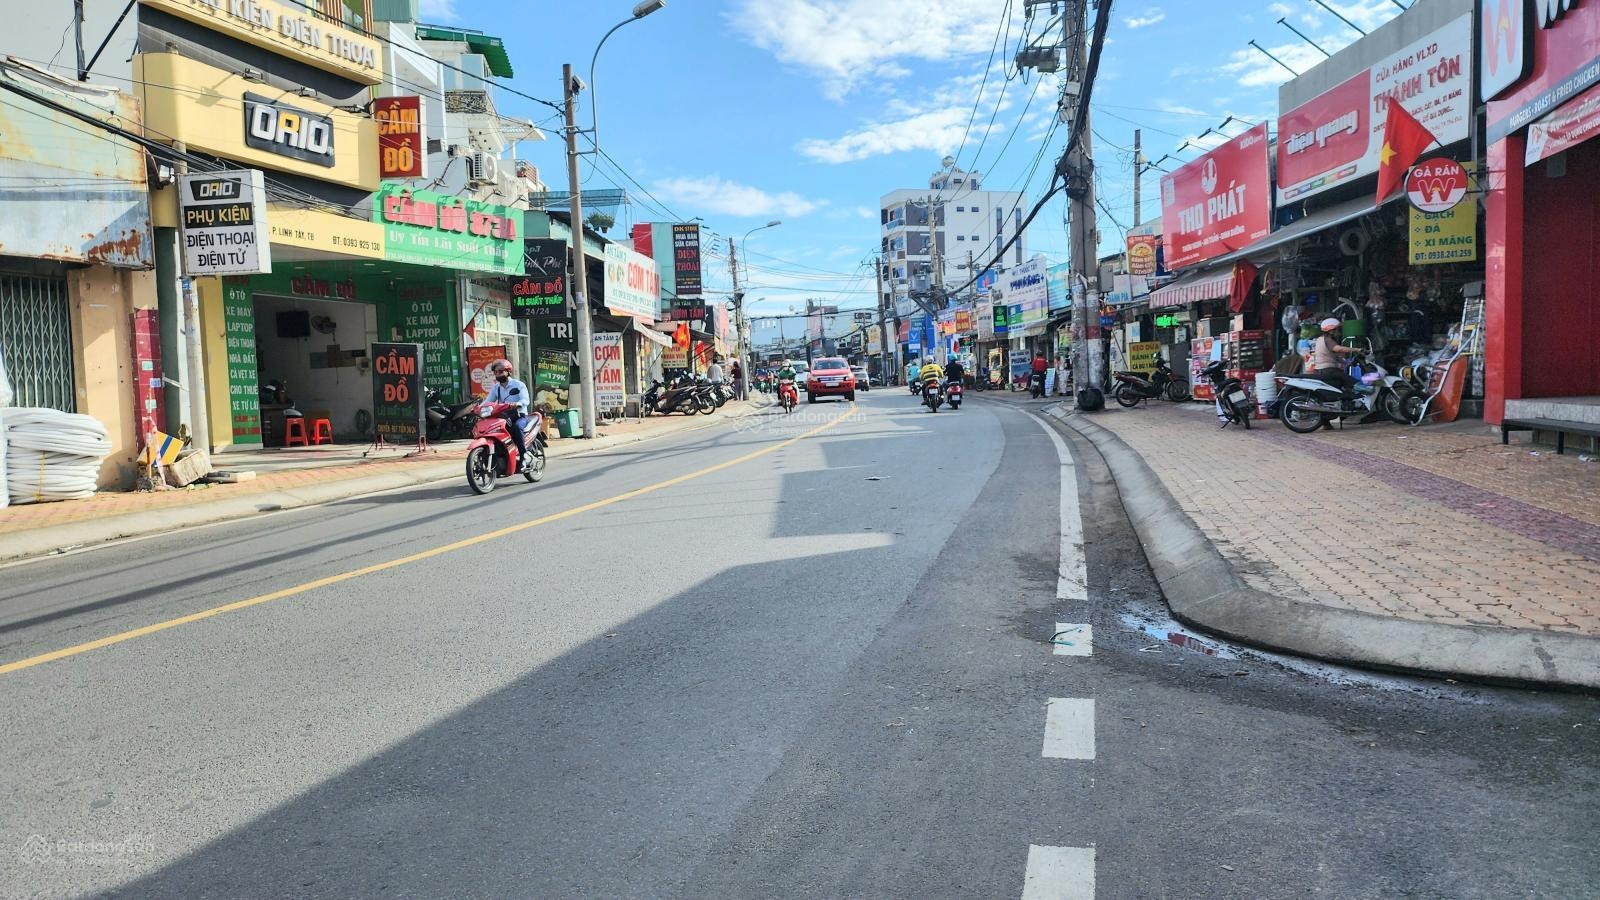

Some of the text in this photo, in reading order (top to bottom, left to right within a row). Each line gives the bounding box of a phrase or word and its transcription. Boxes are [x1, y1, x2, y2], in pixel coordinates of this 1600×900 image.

[1392, 55, 1414, 75] HÀNG
[1416, 43, 1439, 63] VLXD
[1427, 54, 1462, 88] TÔN
[1556, 79, 1573, 100] FRIED
[377, 100, 418, 135] CẦM
[251, 103, 330, 155] ORIO
[384, 137, 415, 173] ĐỒ
[1414, 164, 1460, 178] GÀ RÁN
[1178, 203, 1204, 236] THỌ
[1207, 180, 1248, 225] PHÁT
[187, 205, 251, 226] PHỤ KIỆN
[279, 228, 293, 238] LINH
[1425, 223, 1441, 234] ĐÁ
[187, 231, 255, 249] ĐIỆN THOẠI
[1424, 235, 1473, 247] XI MĂNG
[371, 242, 381, 252] 130
[198, 250, 247, 268] ĐIỆN TỬ
[513, 278, 542, 296] CẦM
[544, 276, 563, 294] ĐỒ
[225, 305, 236, 316] XE
[525, 307, 550, 316] 24/24
[406, 314, 440, 326] XE MÁY
[227, 322, 254, 333] LAPTOP
[406, 328, 441, 339] LAPTOP
[548, 322, 574, 343] TRỊ
[603, 333, 615, 341] TÂM
[229, 351, 255, 364] NHÀ ĐẤT
[427, 350, 442, 363] ĐẤT
[595, 345, 621, 361] CƠM
[375, 348, 416, 376] CẦM
[248, 369, 256, 379] XE
[548, 372, 566, 381] 179K
[230, 385, 243, 395] CHO
[384, 377, 409, 403] ĐỒ
[232, 400, 241, 411] XE
